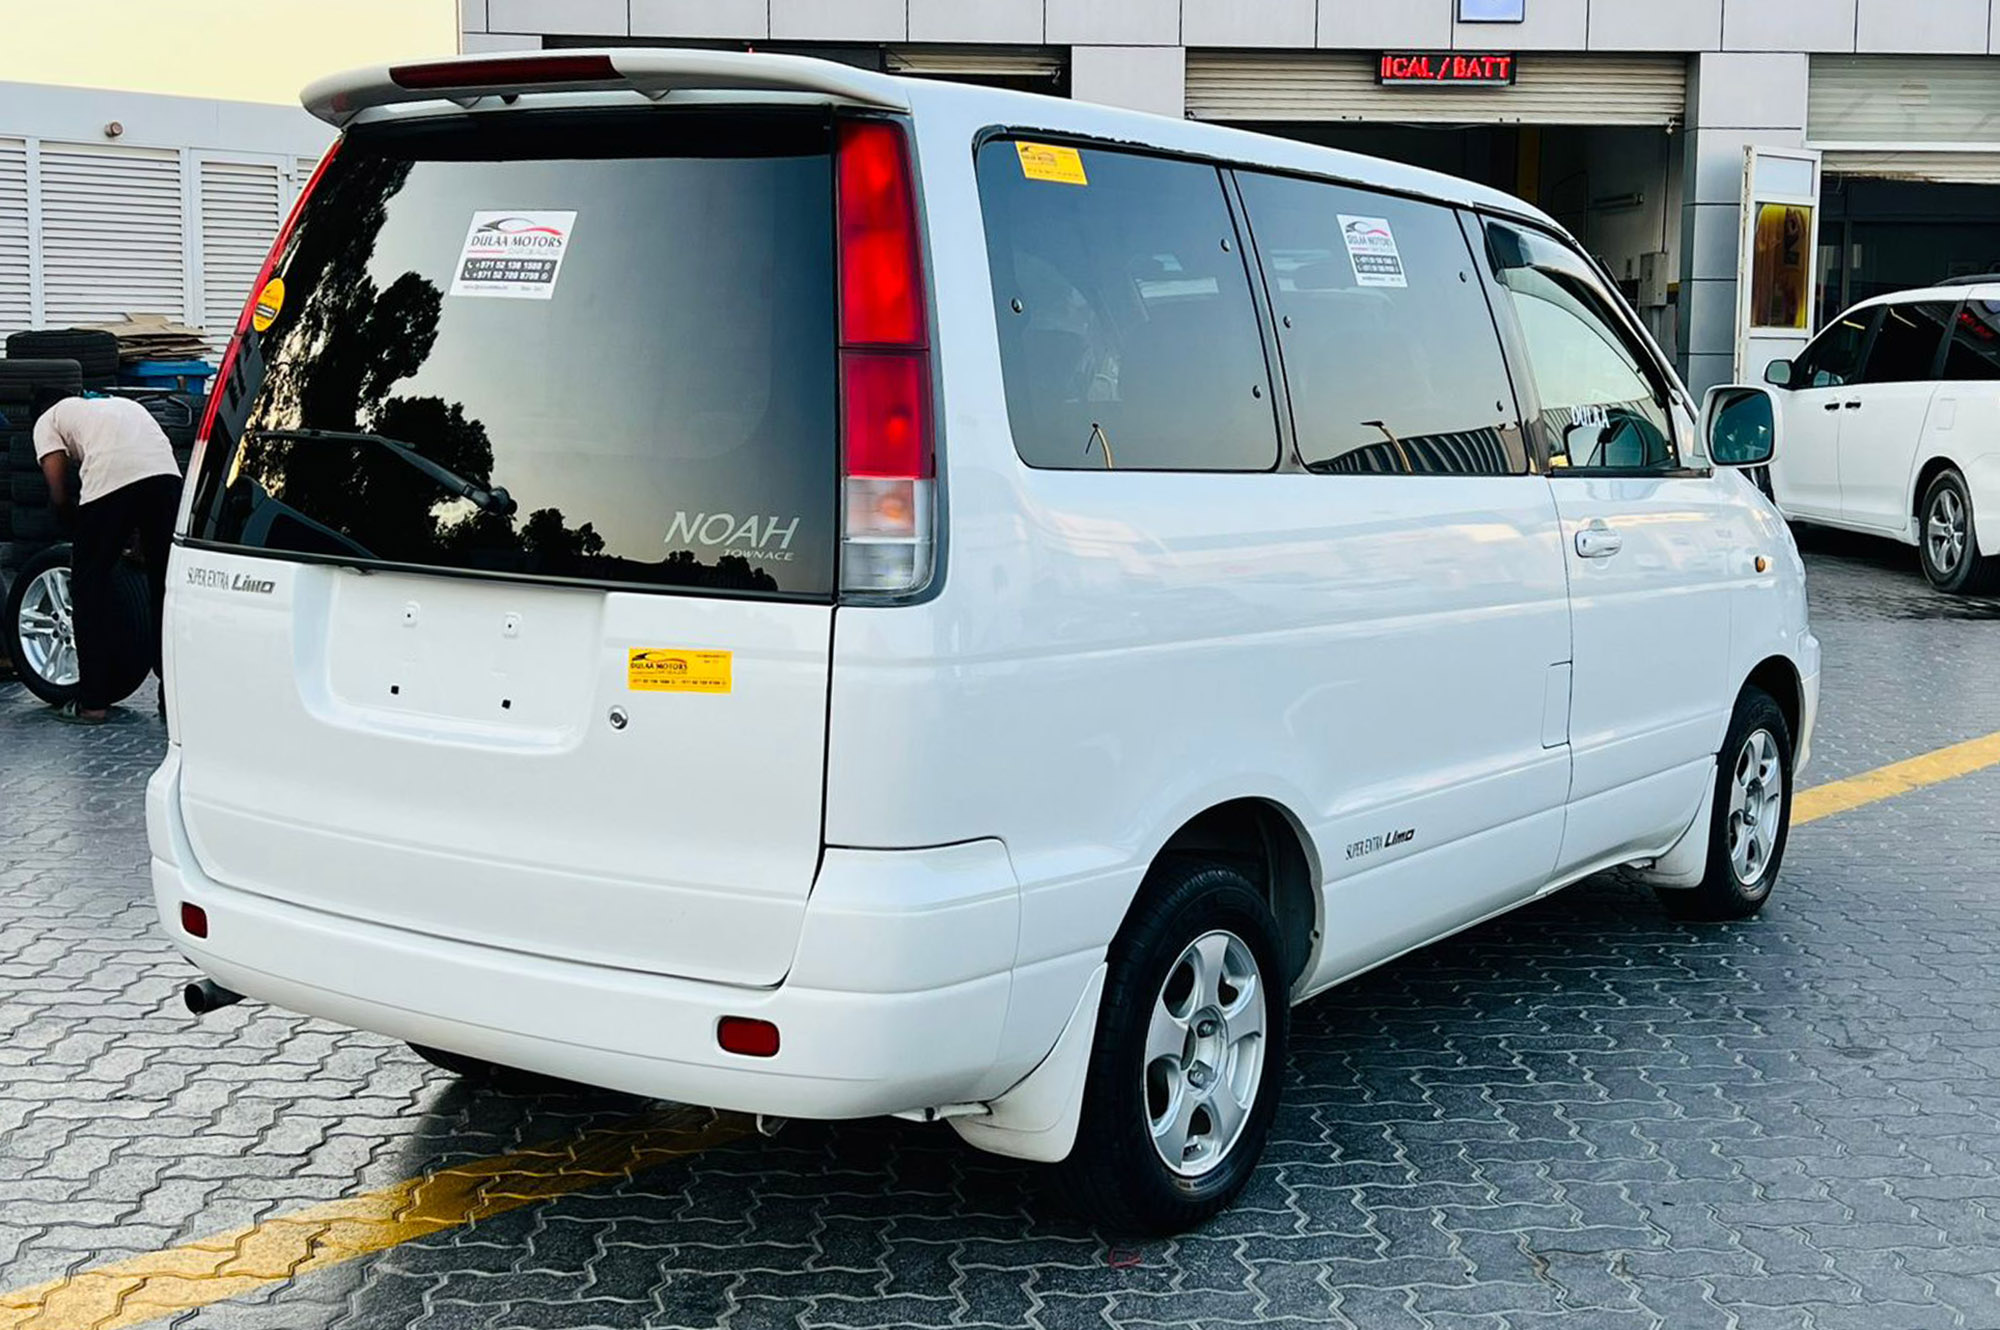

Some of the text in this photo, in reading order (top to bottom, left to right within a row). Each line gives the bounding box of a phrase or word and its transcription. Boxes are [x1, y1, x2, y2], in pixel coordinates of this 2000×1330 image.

[471, 235, 563, 248] DULAA MOTORS
[1571, 405, 1611, 429] DULAA
[664, 511, 800, 549] NOAH
[723, 548, 795, 561] TOWNACE
